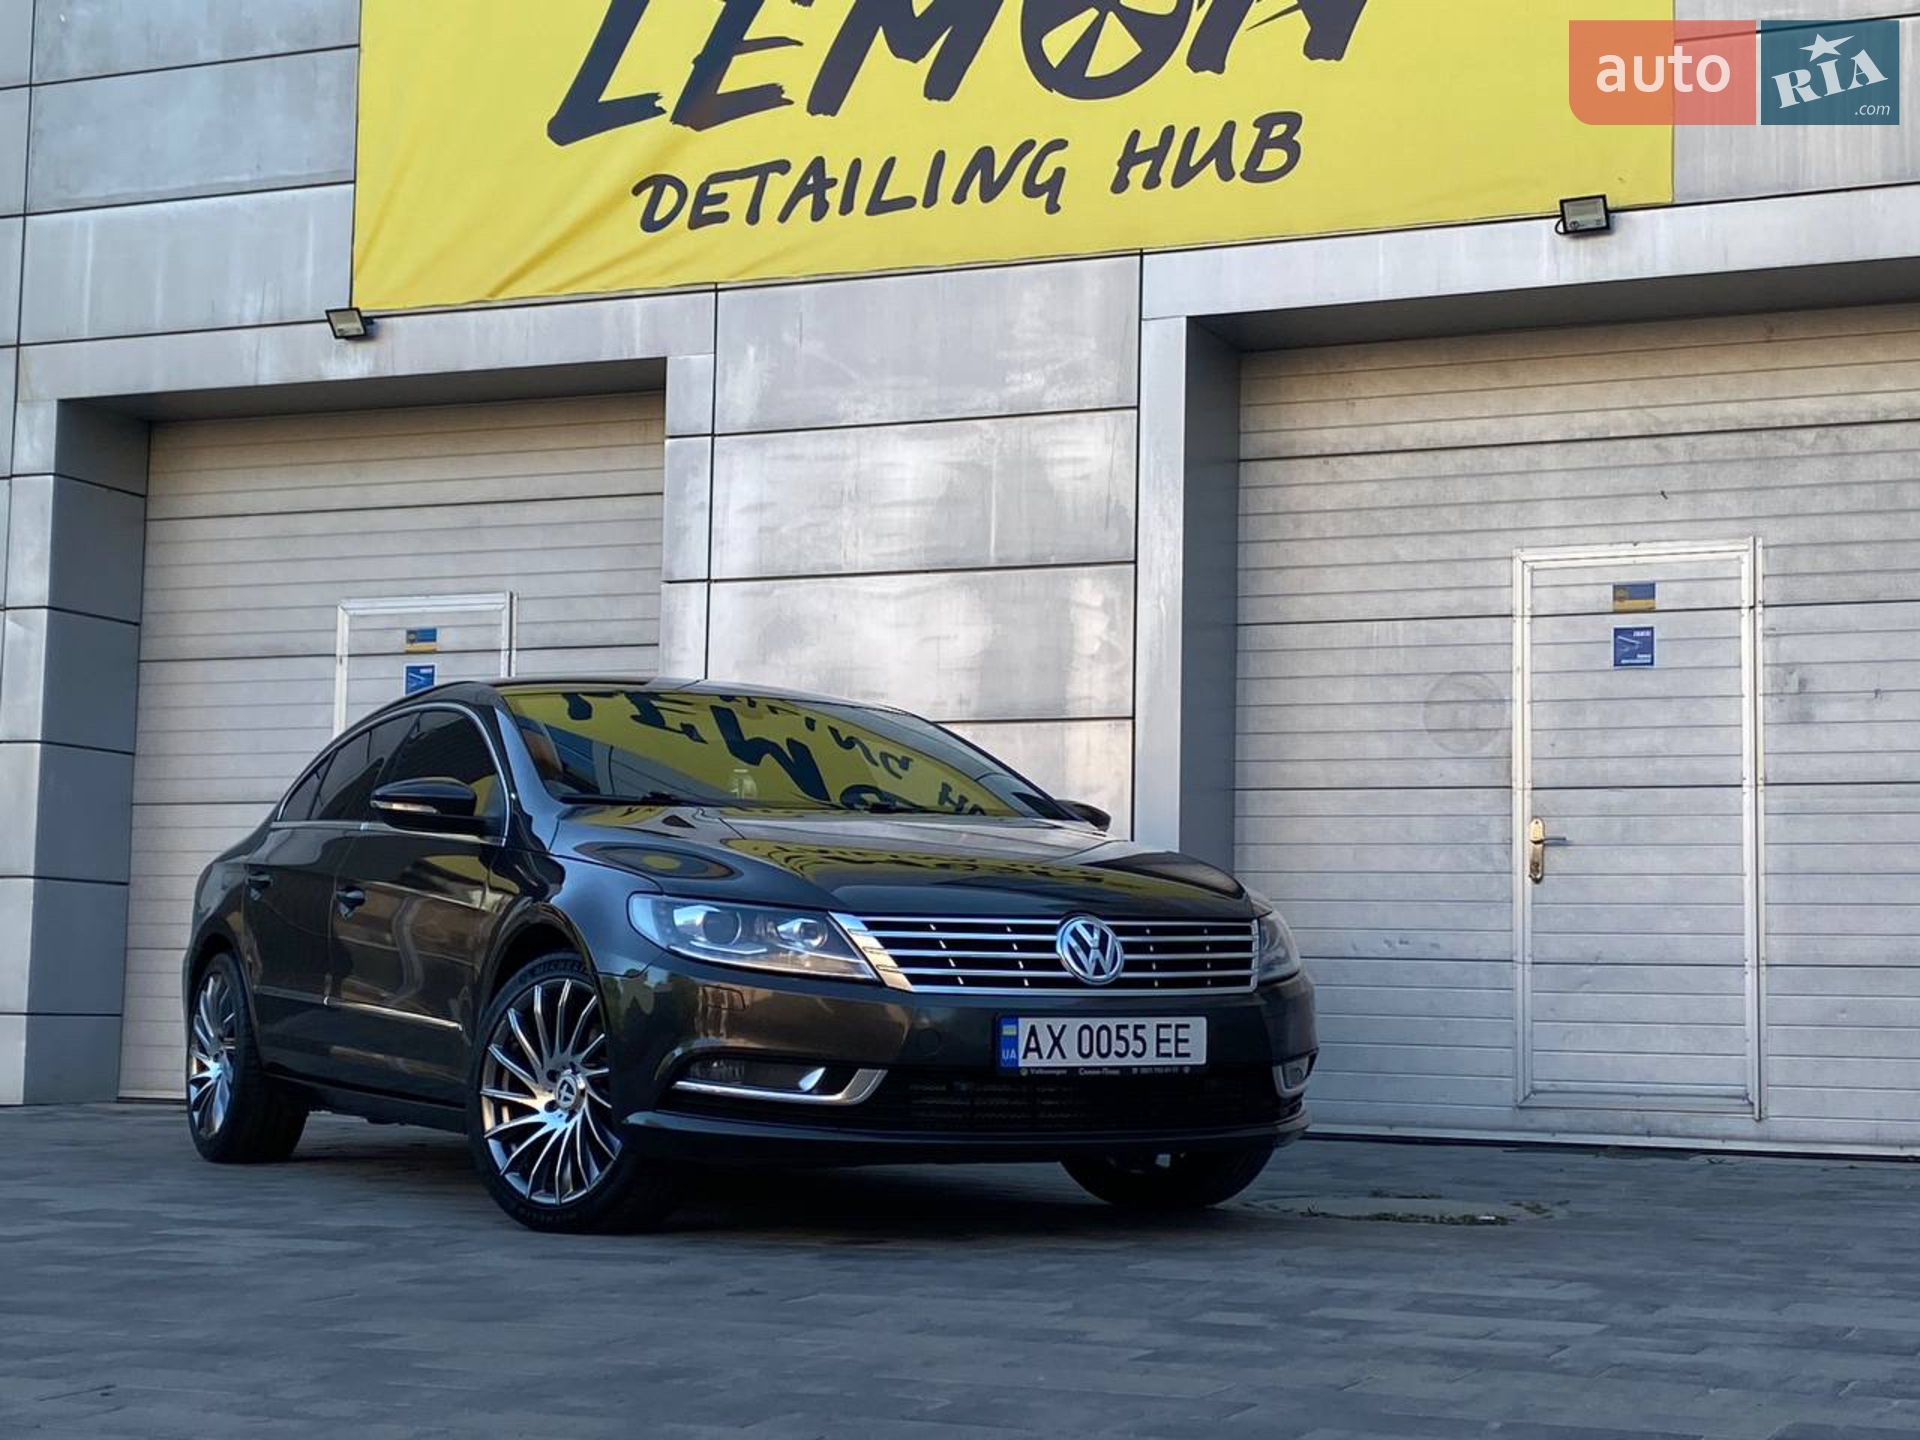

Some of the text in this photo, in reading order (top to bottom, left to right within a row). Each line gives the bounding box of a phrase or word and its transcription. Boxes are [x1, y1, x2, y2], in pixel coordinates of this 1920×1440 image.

[631, 111, 1303, 233] DETAILING HUB
[1001, 1048, 1017, 1061] UA
[1021, 1023, 1192, 1060] AX 0055 EE
